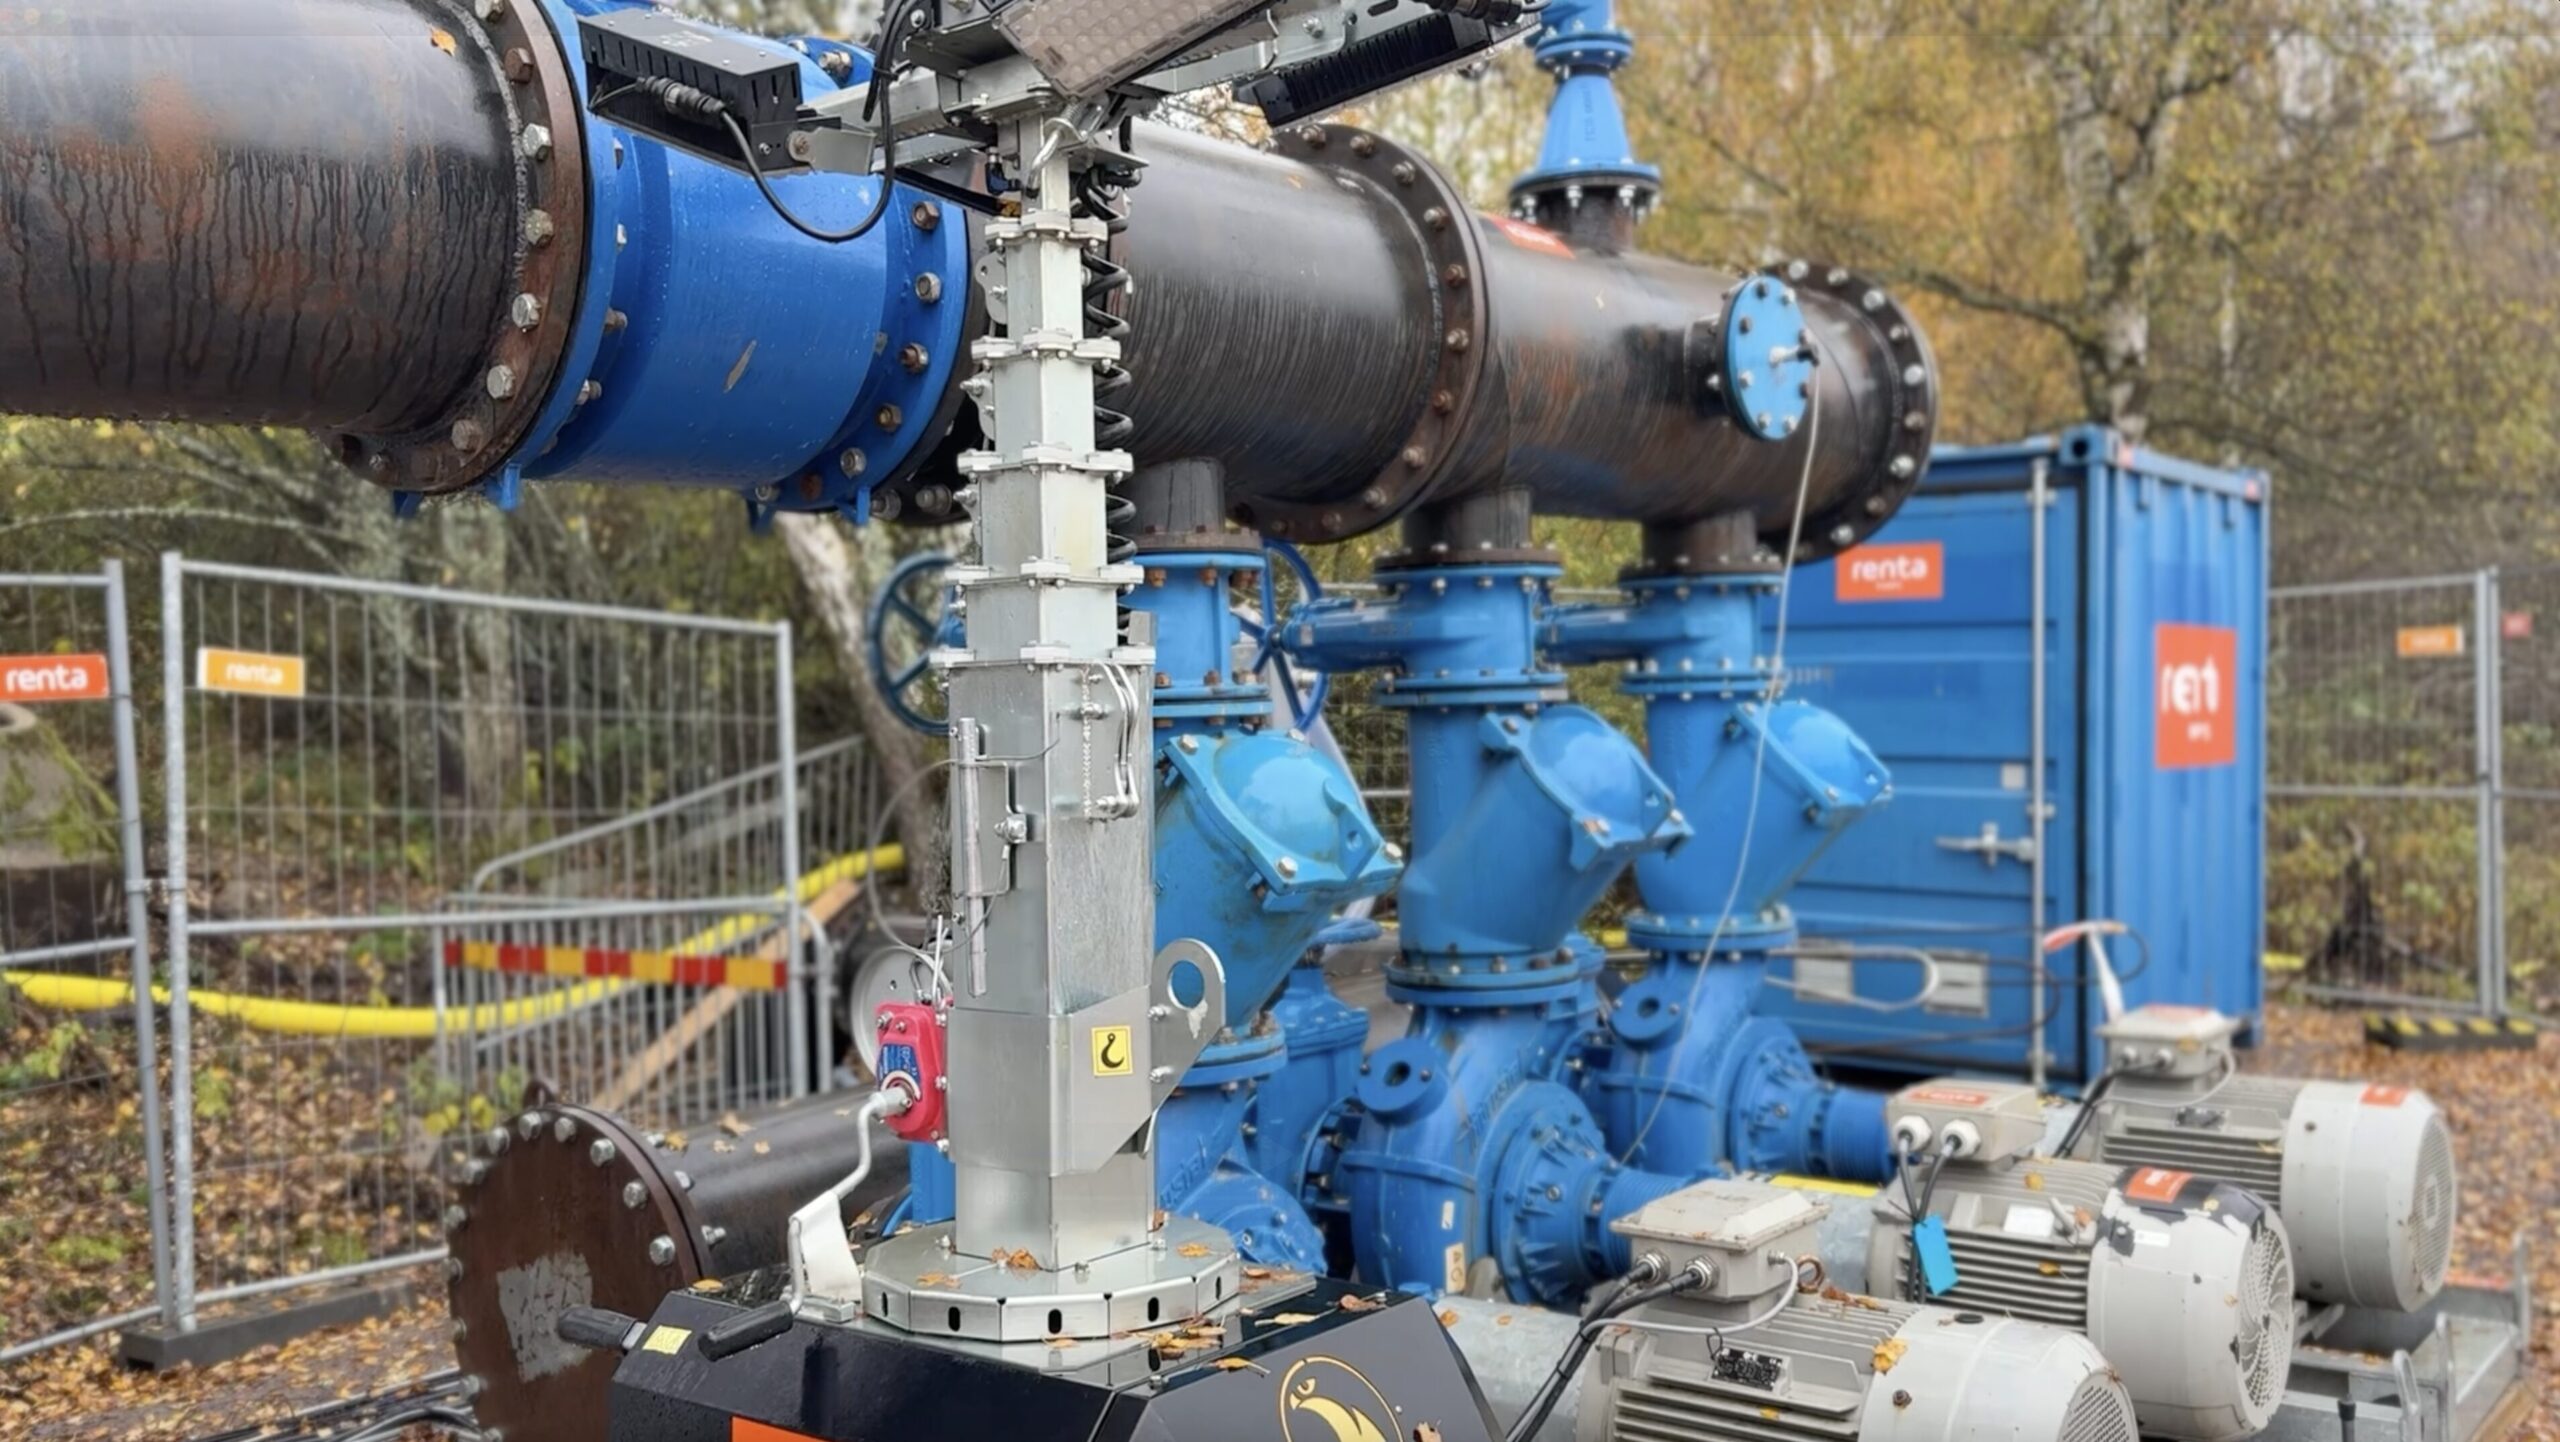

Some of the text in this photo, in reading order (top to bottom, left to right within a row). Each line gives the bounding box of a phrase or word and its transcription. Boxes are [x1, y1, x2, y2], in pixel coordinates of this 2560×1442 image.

[1850, 556, 1928, 582] renta
[6, 664, 88, 693] renta
[226, 663, 283, 685] renta
